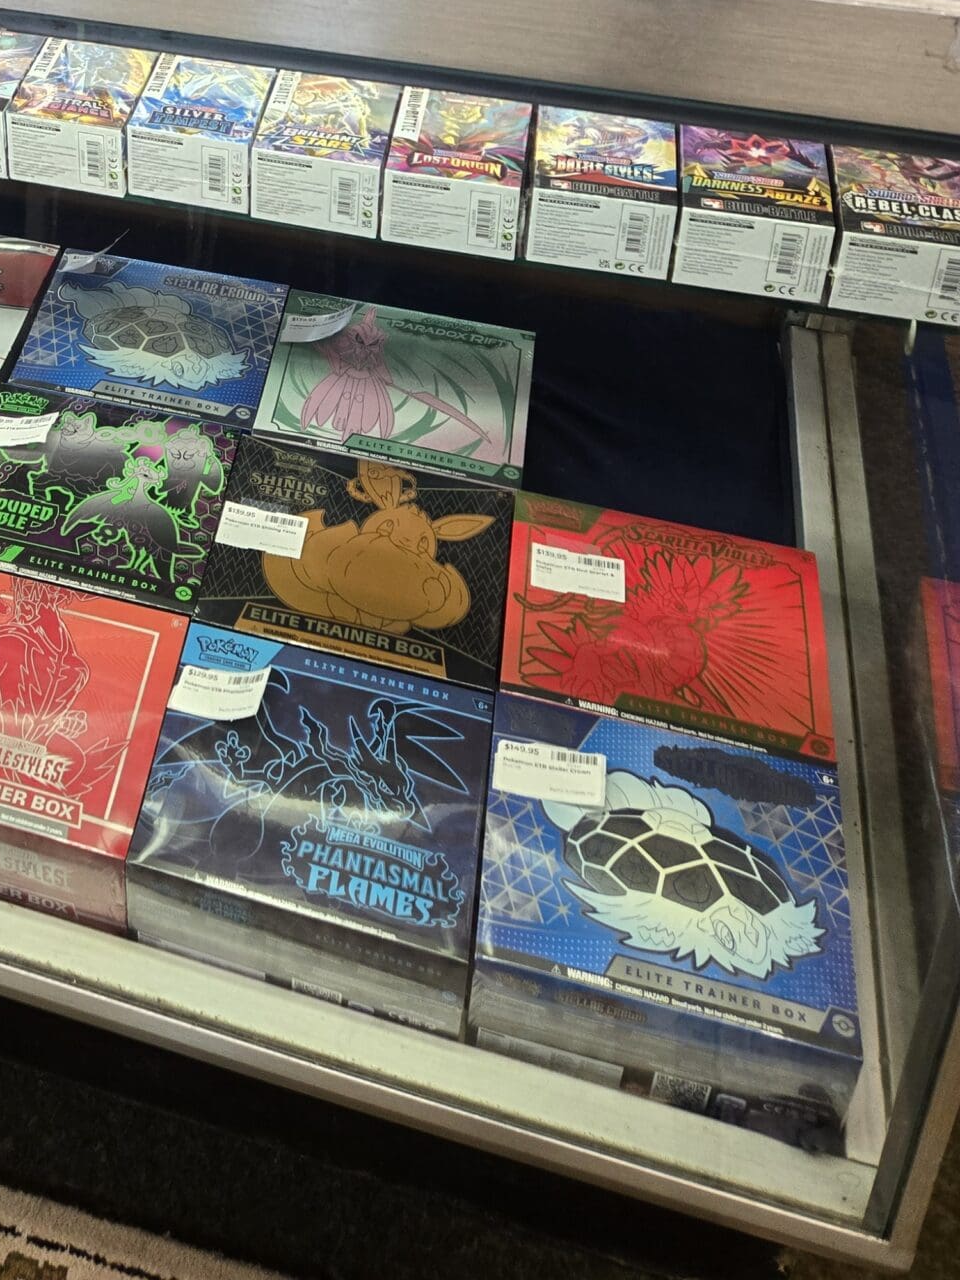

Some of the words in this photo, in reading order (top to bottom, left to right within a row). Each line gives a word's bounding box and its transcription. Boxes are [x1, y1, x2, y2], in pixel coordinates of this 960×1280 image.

[52, 97, 104, 110] STRAL
[164, 107, 226, 121] SILVER
[152, 112, 234, 134] TEMPEST
[284, 126, 360, 144] BRILLIANT
[293, 136, 354, 151] STARS
[412, 152, 448, 168] LOST
[450, 159, 503, 179] ORIGIN
[604, 164, 654, 181] STYLES
[691, 176, 763, 195] DARKNESS
[765, 189, 827, 207] ABLAZE
[164, 276, 219, 295] STELLAR
[220, 284, 267, 302] CROWN
[390, 320, 465, 340] PARADOX
[469, 332, 508, 349] RIFT
[104, 384, 135, 396] ELITE
[141, 390, 191, 407] TRAINER
[196, 401, 221, 413] BOX
[358, 439, 392, 452] ELITE
[398, 447, 453, 465] TRAINER
[460, 463, 487, 473] BOX
[250, 472, 329, 496] SHINING
[259, 484, 315, 506] FATES
[625, 525, 698, 550] SCARLET
[705, 540, 771, 567] VIOLET
[29, 555, 65, 570] ELITE
[70, 564, 126, 584] TRAINER
[131, 579, 158, 592] BOX
[249, 606, 302, 630] ELITE
[304, 615, 390, 651] TRAINER
[394, 635, 438, 663] BOX
[196, 635, 259, 662] Pokémon
[188, 668, 219, 682] $129.95
[304, 657, 345, 676] ELITE
[352, 669, 415, 693] TRAINER
[422, 686, 450, 701] BOX
[578, 699, 619, 716] WARNING:
[504, 743, 540, 756] $149.95
[30, 794, 76, 820] BOX
[329, 827, 361, 845] MEGA
[362, 835, 424, 867] EVOLUTION
[296, 841, 450, 902] PHANTASMAL
[306, 863, 434, 925] FLAMES
[567, 966, 614, 988] WARNING:
[625, 964, 673, 986] ELITE
[683, 980, 762, 1010] TRAINER
[771, 1004, 808, 1024] BOX
